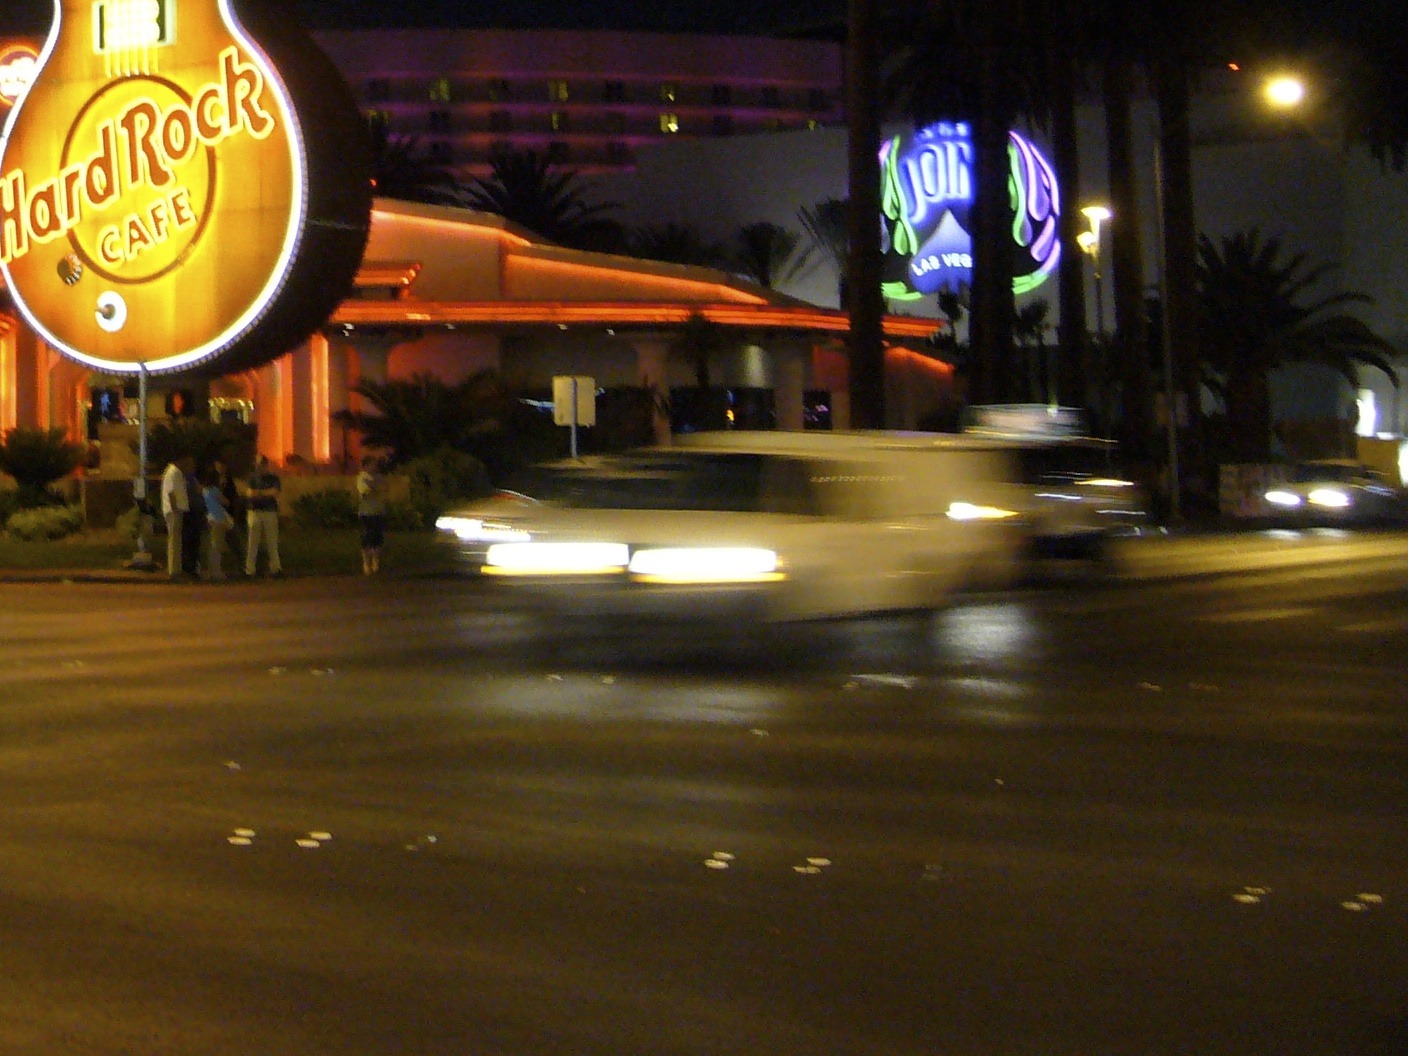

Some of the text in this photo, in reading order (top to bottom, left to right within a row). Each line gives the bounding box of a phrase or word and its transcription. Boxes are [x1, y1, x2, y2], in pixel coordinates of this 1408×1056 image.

[122, 47, 275, 188] Rock
[97, 187, 196, 267] CAFE
[911, 252, 972, 277] LAS VEG
